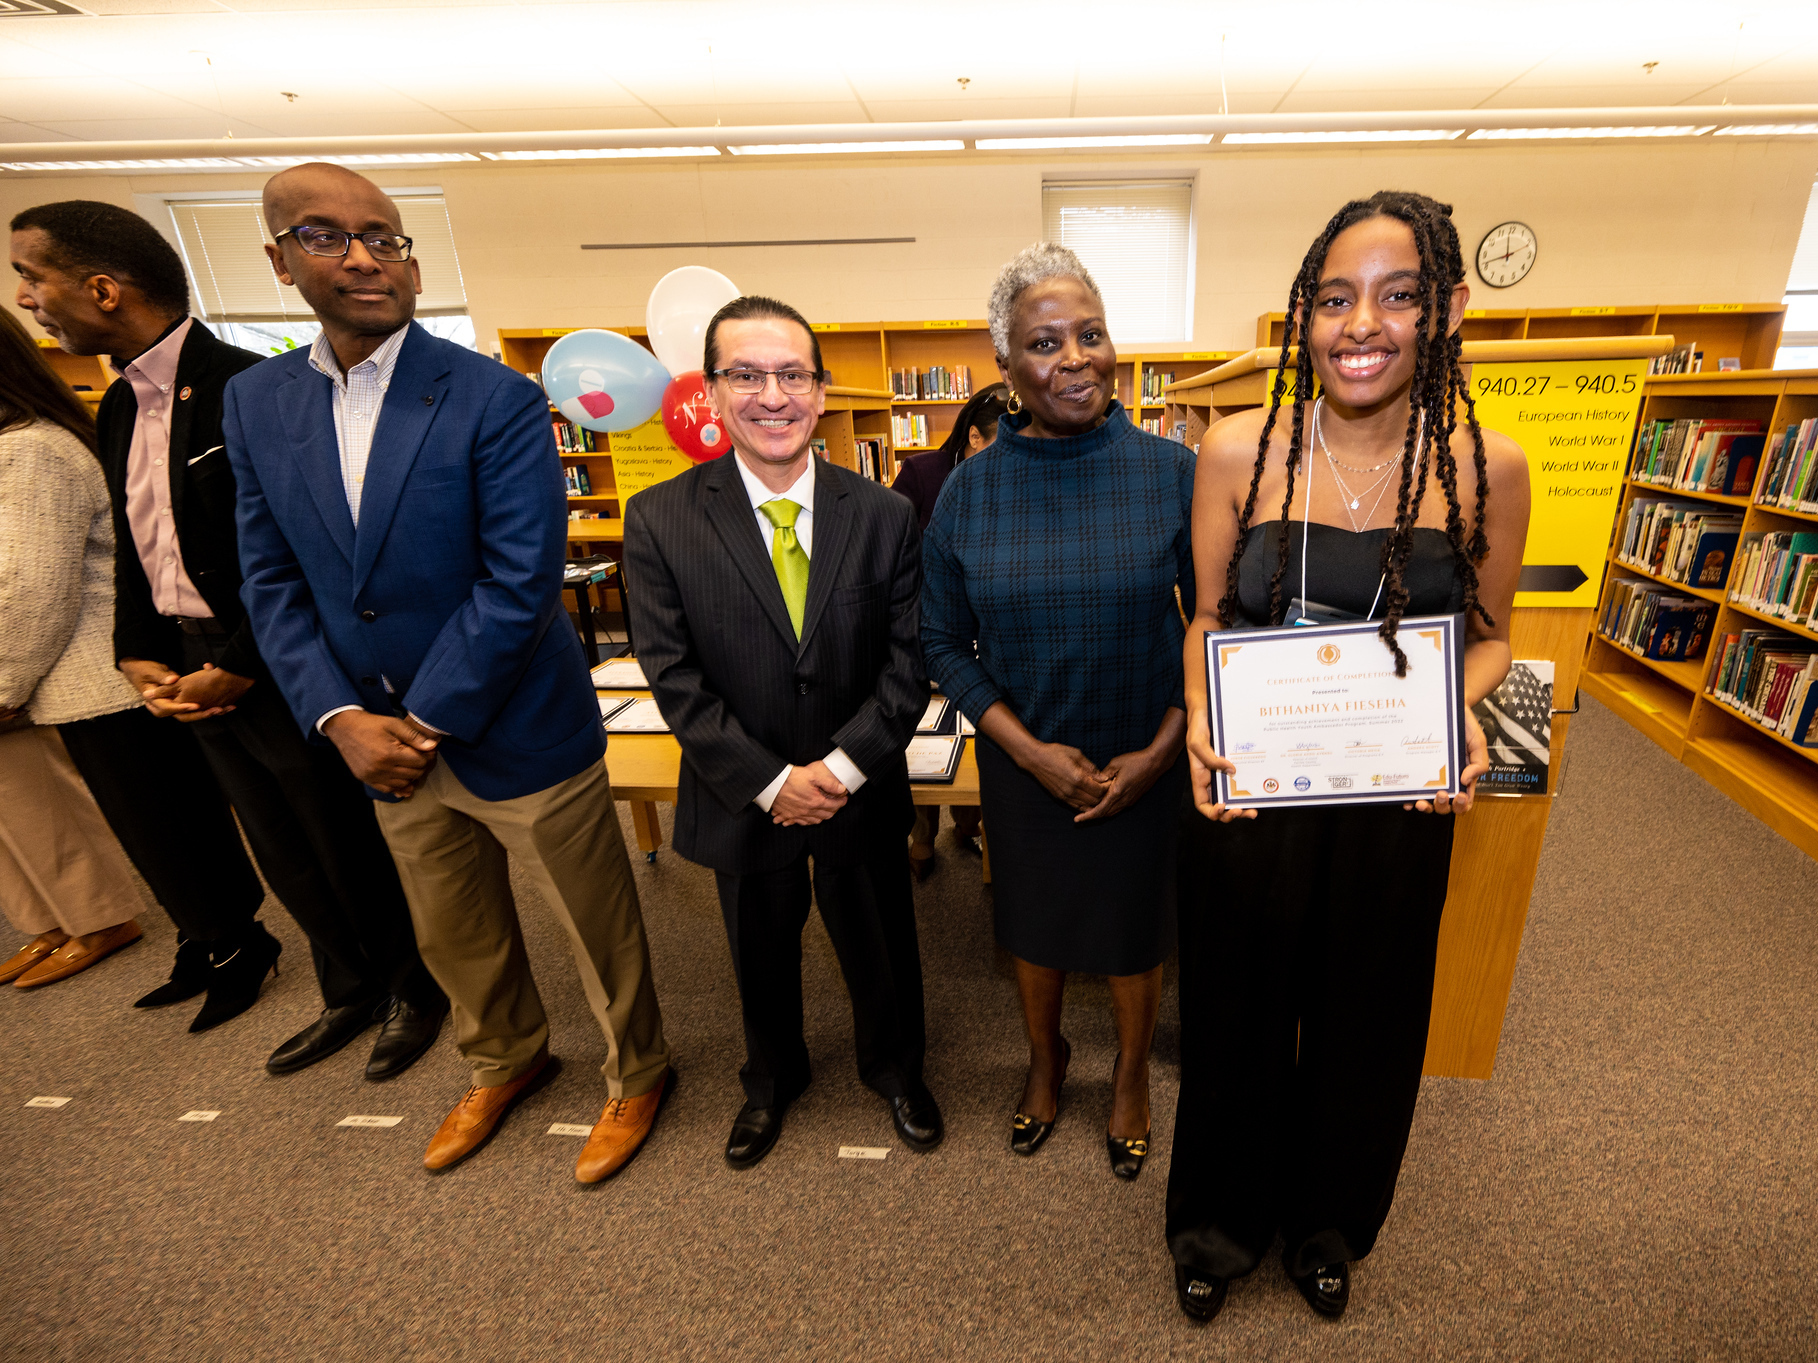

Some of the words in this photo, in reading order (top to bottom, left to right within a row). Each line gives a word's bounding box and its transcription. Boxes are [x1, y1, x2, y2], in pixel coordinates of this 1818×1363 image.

[1478, 376, 1551, 397] 940.27
[1575, 374, 1638, 394] 940.5
[1518, 410, 1582, 424] European
[1586, 409, 1630, 422] History
[1549, 435, 1586, 447] World
[1590, 435, 1617, 446] War
[1621, 435, 1625, 446] I
[1541, 460, 1578, 472] World
[1582, 460, 1609, 472] War
[1612, 460, 1619, 471] II
[1548, 485, 1613, 497] Holocaust
[1266, 677, 1321, 686] CERTIFICATE
[1260, 703, 1340, 717] BITHANIYA
[1491, 773, 1538, 783] FREEDOM
